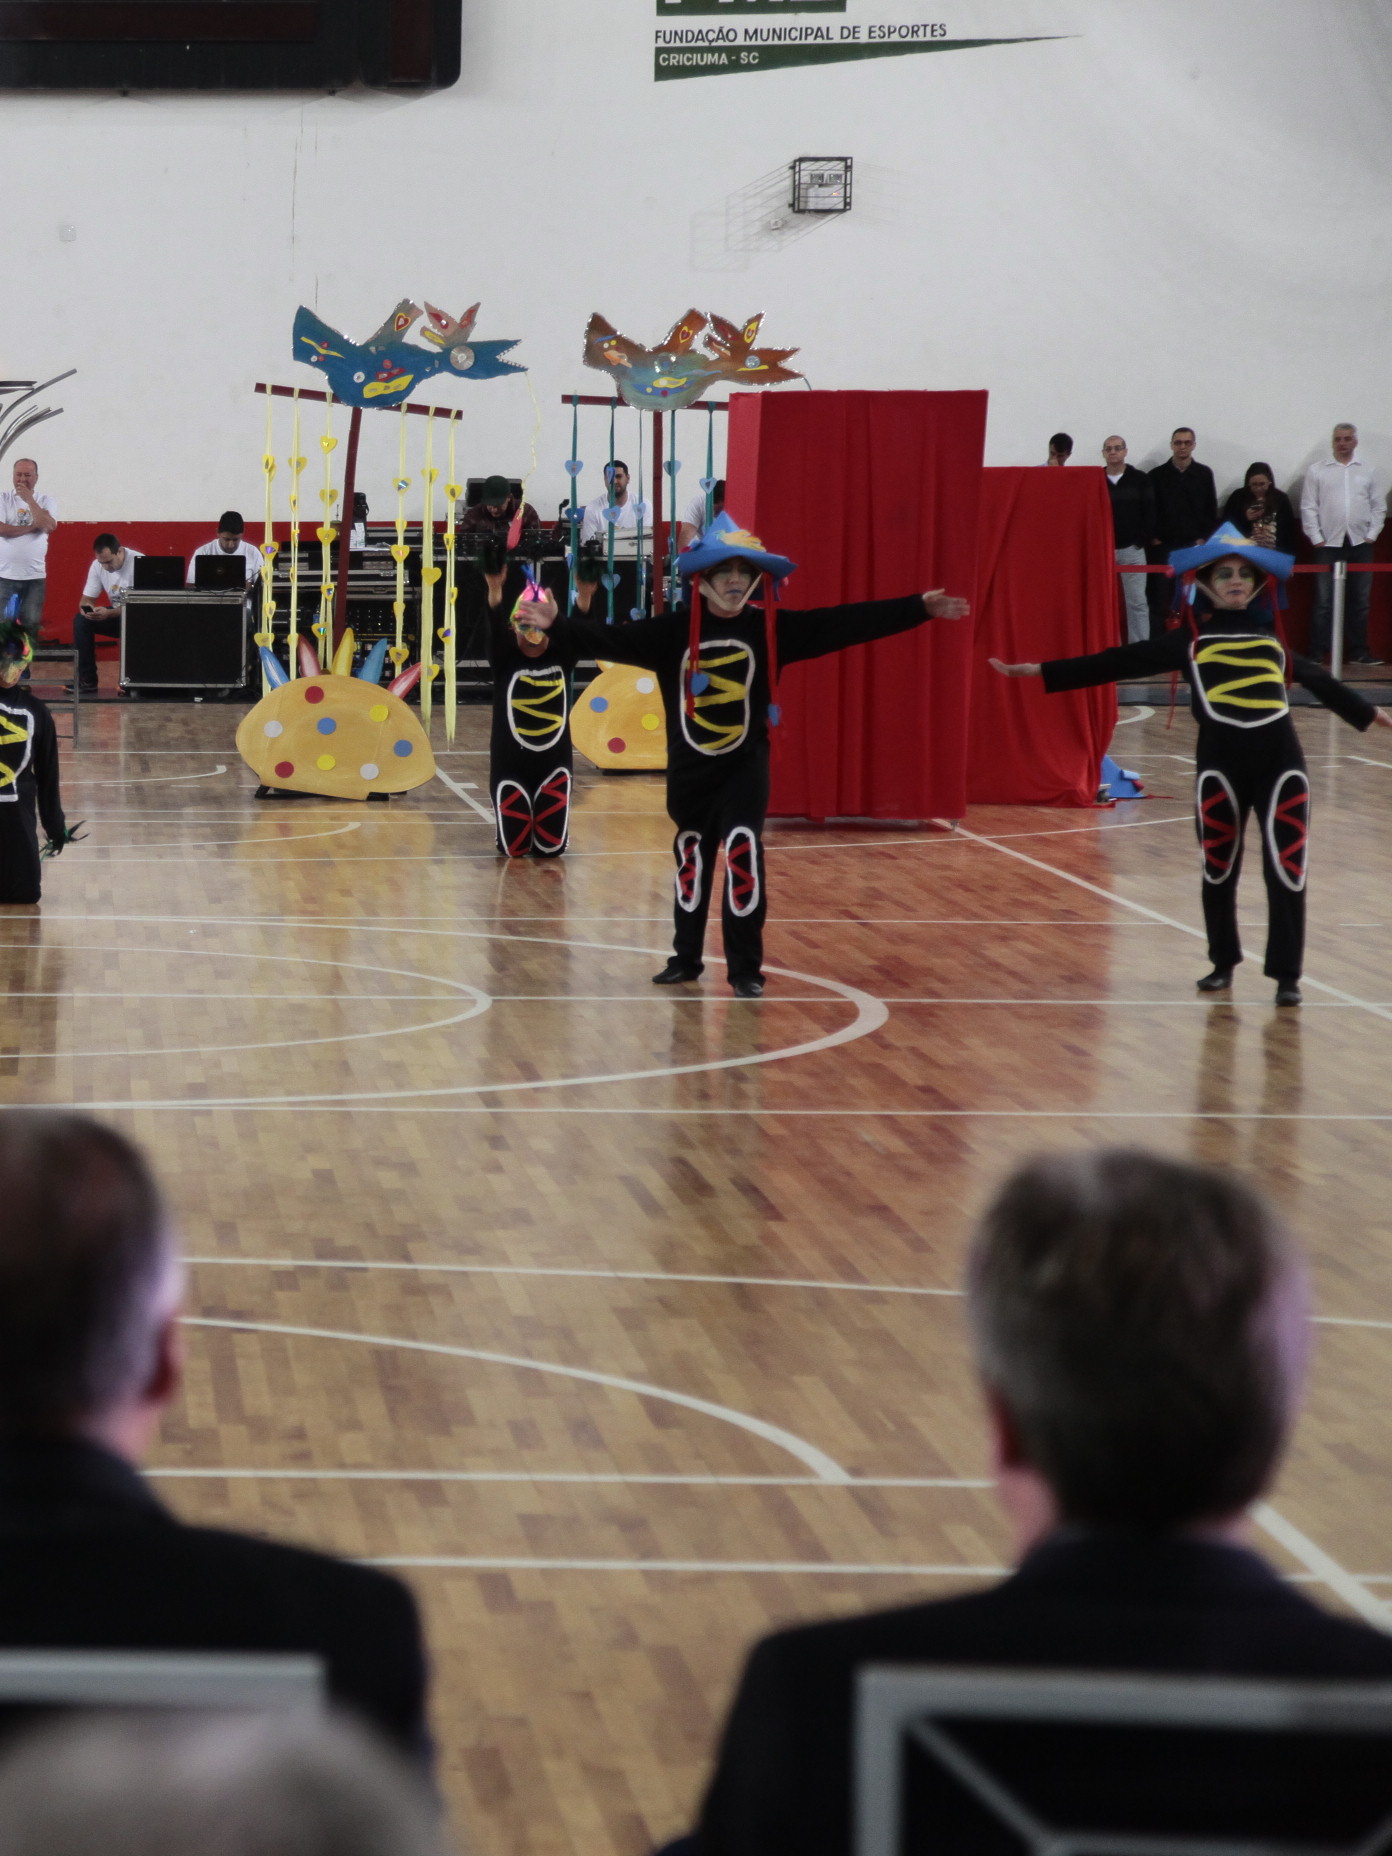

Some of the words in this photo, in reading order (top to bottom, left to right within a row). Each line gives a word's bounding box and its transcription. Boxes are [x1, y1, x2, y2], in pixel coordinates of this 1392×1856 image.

[655, 26, 738, 46] FUNDAÇÃO
[744, 26, 834, 42] MUNICIPAL
[840, 25, 861, 40] DE
[868, 23, 947, 39] ESPORTES
[659, 53, 729, 67] CRICIUMA
[740, 52, 760, 65] SC
